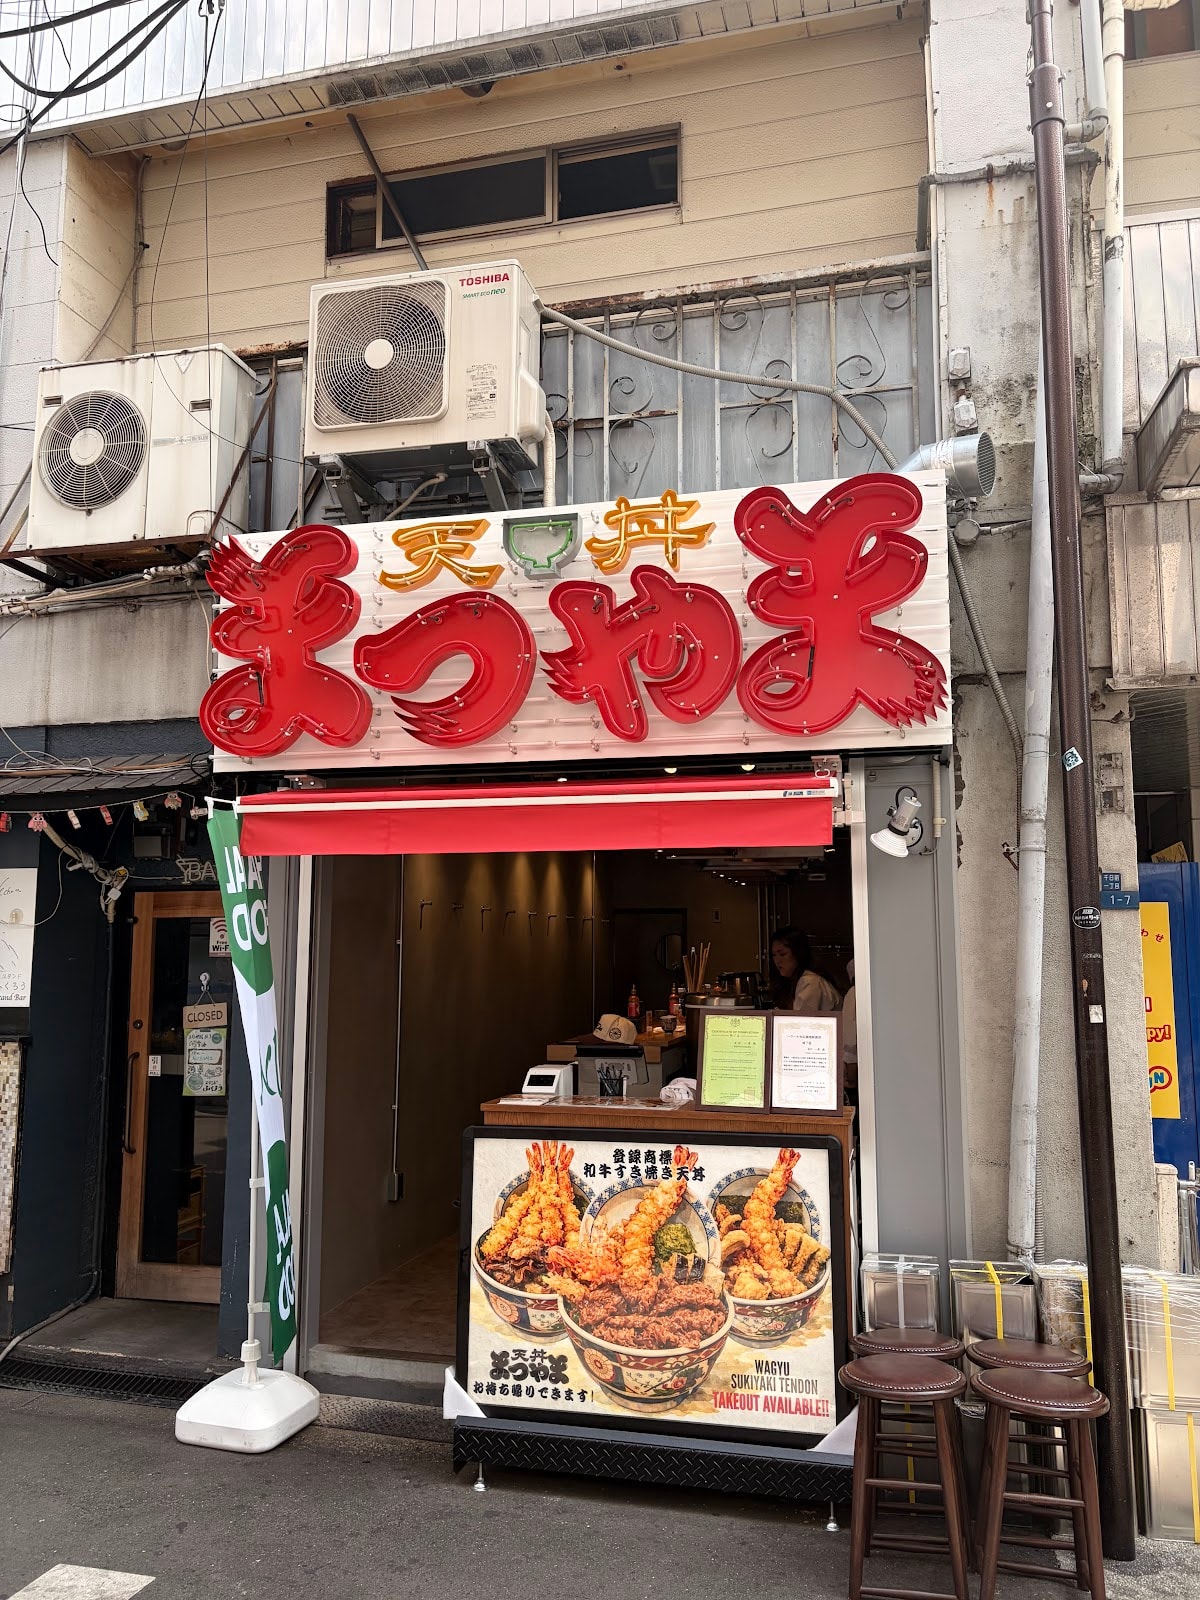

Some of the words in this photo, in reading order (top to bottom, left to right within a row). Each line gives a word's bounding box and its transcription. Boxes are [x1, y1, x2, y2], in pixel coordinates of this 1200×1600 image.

[459, 273, 509, 286] TOSHIBA
[379, 488, 716, 593] 天丼
[199, 472, 949, 758] まつやま
[187, 861, 217, 881] BA
[1110, 895, 1131, 905] 1-7
[187, 1010, 223, 1022] CLOSED
[1146, 1025, 1171, 1042] py!
[613, 1148, 673, 1165] 登録商標
[583, 1162, 706, 1182] 和牛すき焼き天丼
[511, 1348, 549, 1363] 天丼
[489, 1350, 570, 1385] まつやま
[755, 1359, 790, 1376] WAGYU
[731, 1373, 776, 1392] SUKIYAKI
[778, 1377, 818, 1395] TENDON
[712, 1391, 760, 1412] TAKEOUT
[763, 1395, 830, 1417] AVAILABLE!!
